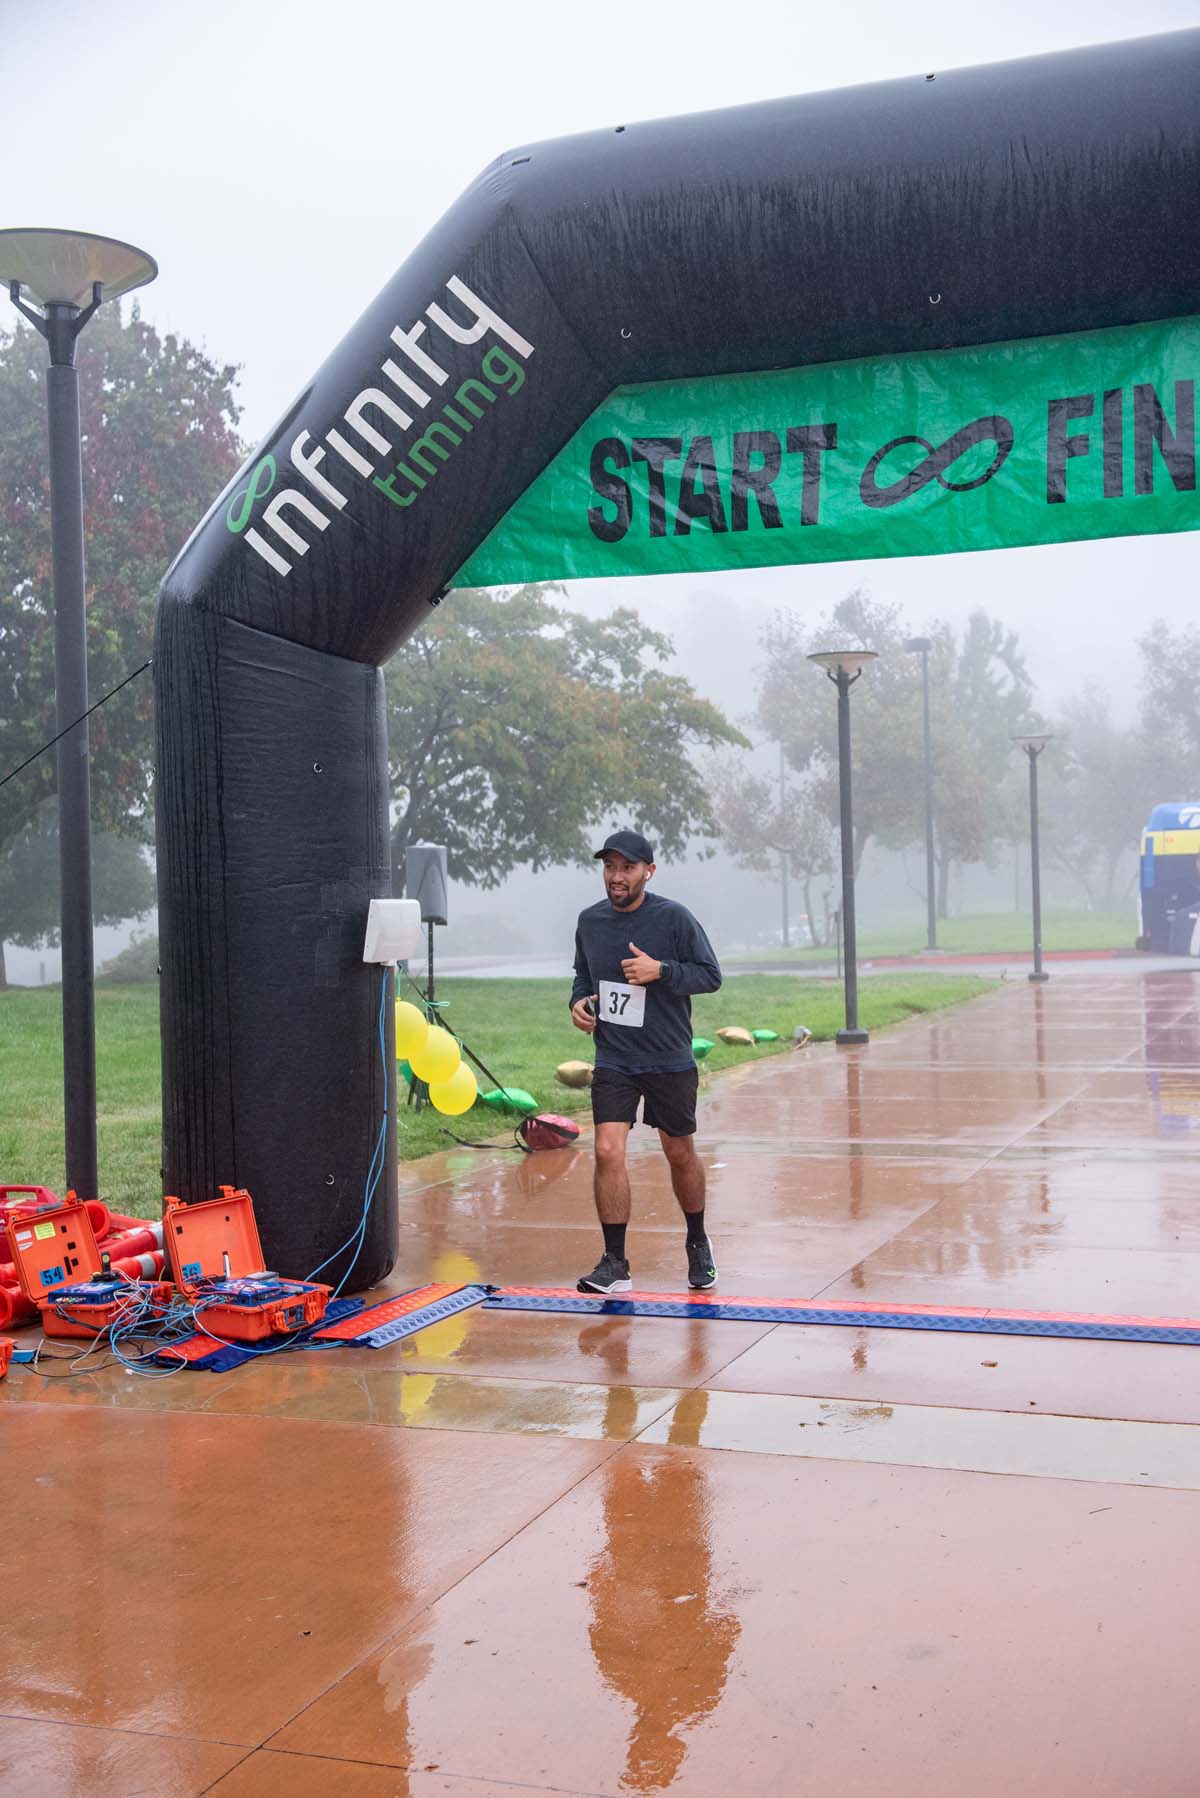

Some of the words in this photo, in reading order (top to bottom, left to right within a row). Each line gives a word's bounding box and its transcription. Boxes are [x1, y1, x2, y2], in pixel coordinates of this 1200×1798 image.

[244, 275, 535, 577] infinity
[372, 345, 526, 507] timing
[587, 423, 838, 543] START
[1047, 379, 1197, 504] FIN
[609, 991, 631, 1016] 37
[42, 1265, 63, 1285] 54
